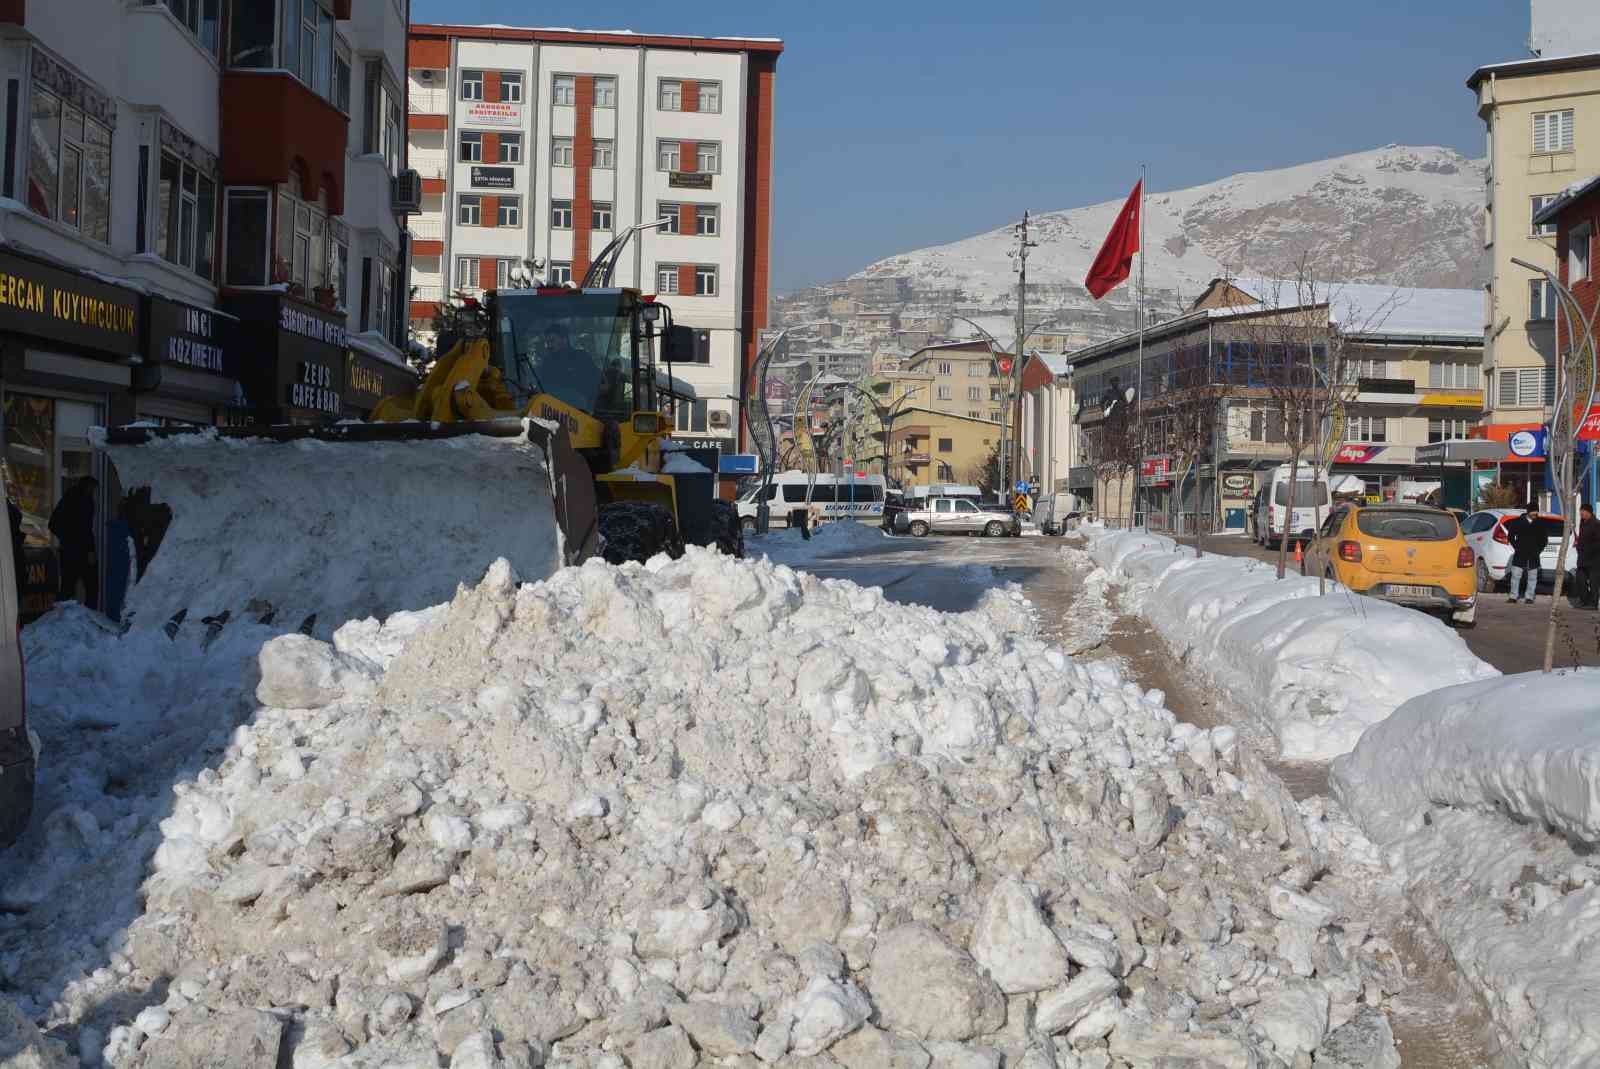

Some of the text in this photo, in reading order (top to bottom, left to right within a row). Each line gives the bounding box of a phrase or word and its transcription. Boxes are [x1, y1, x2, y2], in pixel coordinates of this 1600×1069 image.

[0, 272, 136, 335] ERCAN KUYUMCULUK
[304, 360, 331, 389] ZEUS
[292, 384, 316, 409] CAFE
[323, 390, 341, 416] BAR
[693, 440, 722, 449] CAFE
